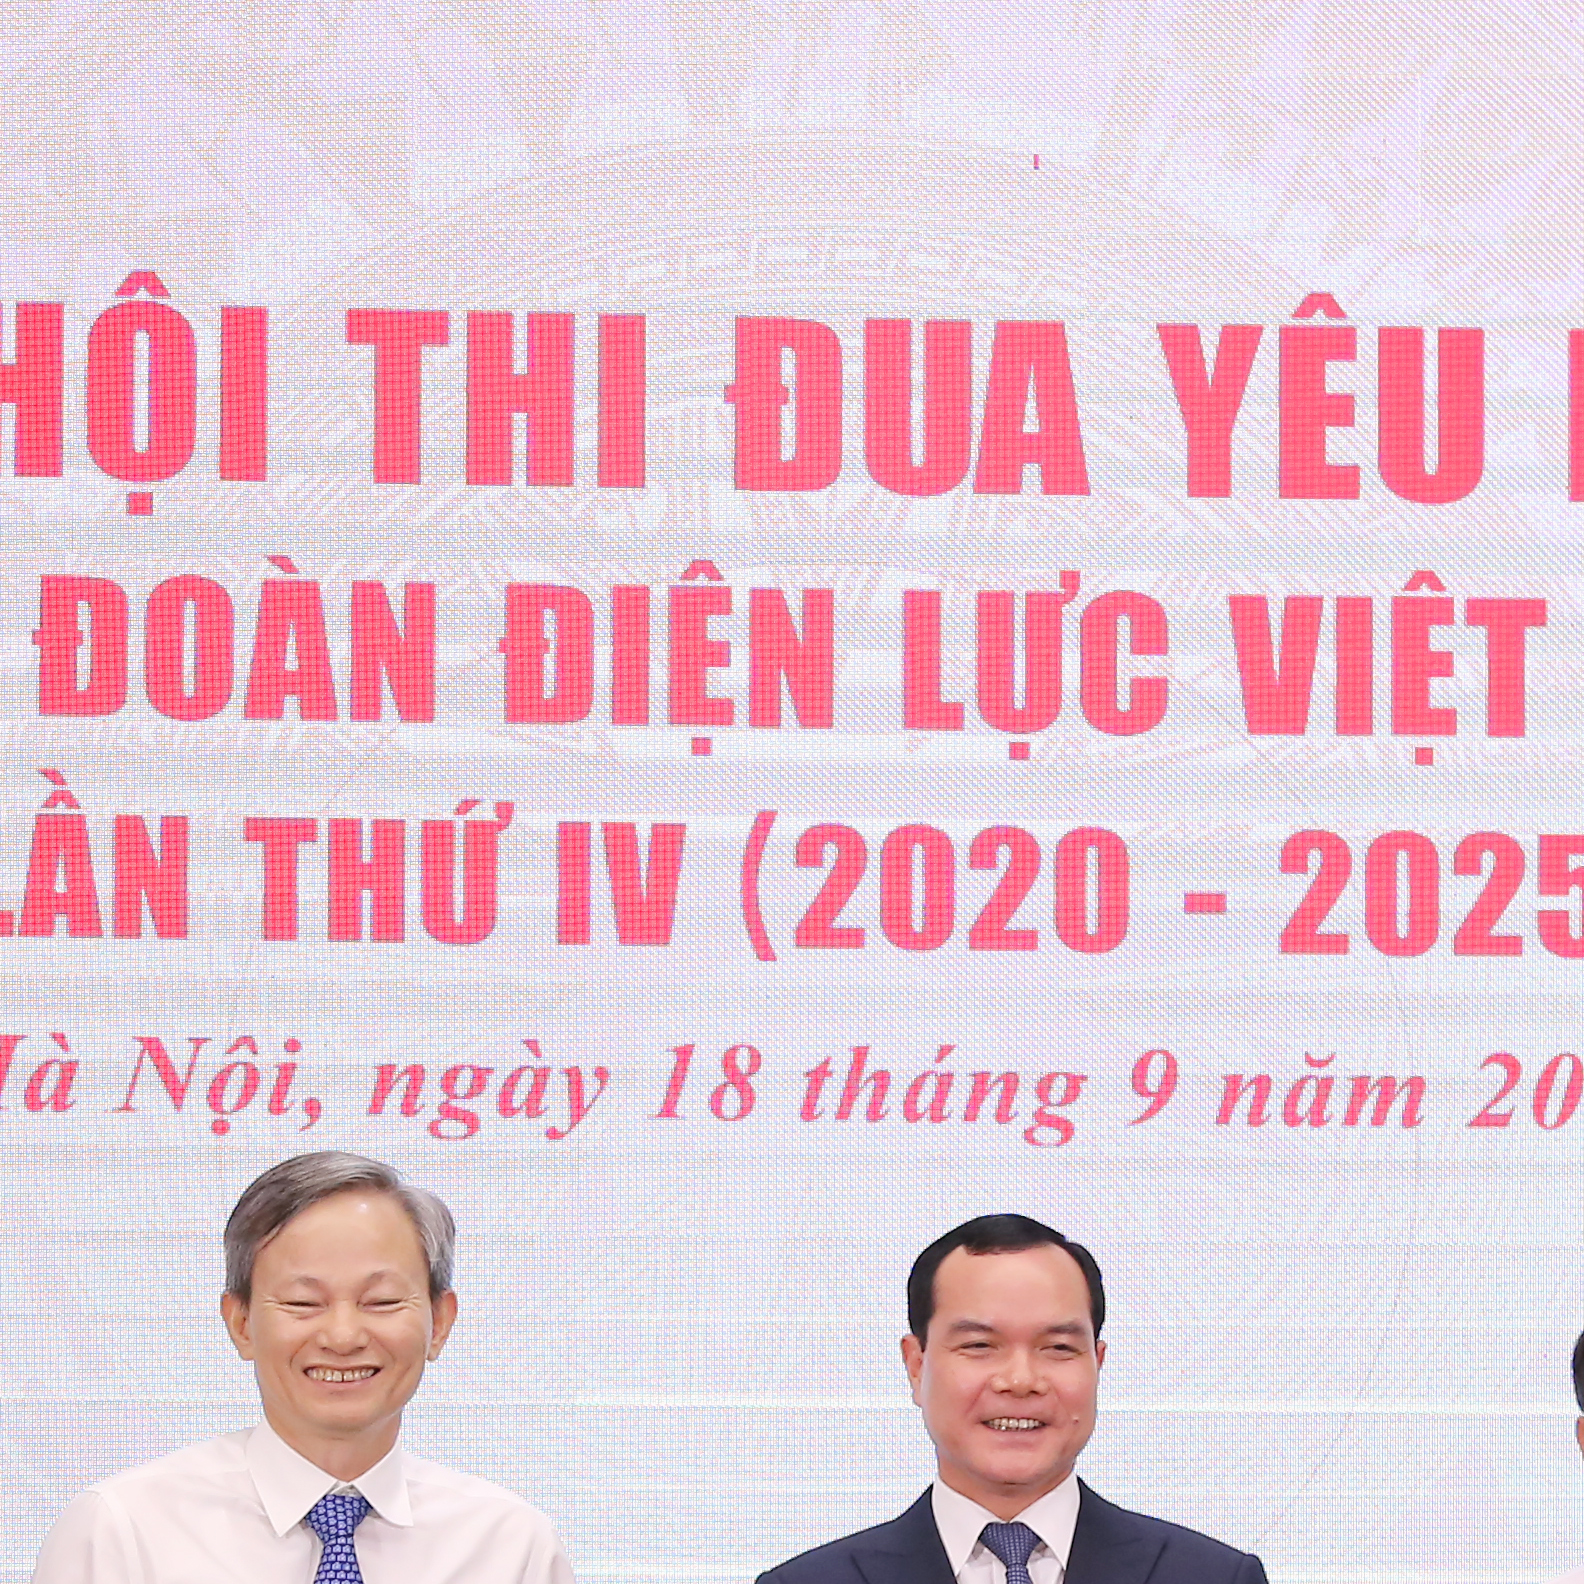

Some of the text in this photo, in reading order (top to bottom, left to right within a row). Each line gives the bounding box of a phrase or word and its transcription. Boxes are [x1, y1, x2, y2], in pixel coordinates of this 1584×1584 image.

[344, 307, 648, 490] THI
[724, 315, 1091, 498] ĐUA
[1157, 291, 1486, 507] YÊU
[31, 554, 437, 726] ĐOÀN
[496, 559, 836, 756] ĐIỆN
[902, 569, 1169, 761] LỰC
[1227, 569, 1549, 766] VIỆT
[243, 800, 515, 946] THỨ
[557, 821, 686, 946] IV
[740, 810, 1131, 962] (2020
[1184, 891, 1227, 914] -
[120, 1035, 323, 1137] Nội,
[367, 1038, 610, 1142] ngày
[658, 1044, 762, 1121] 18
[799, 1045, 1076, 1144] tháng
[1131, 1050, 1179, 1119] 9
[1216, 1056, 1426, 1129] năm
